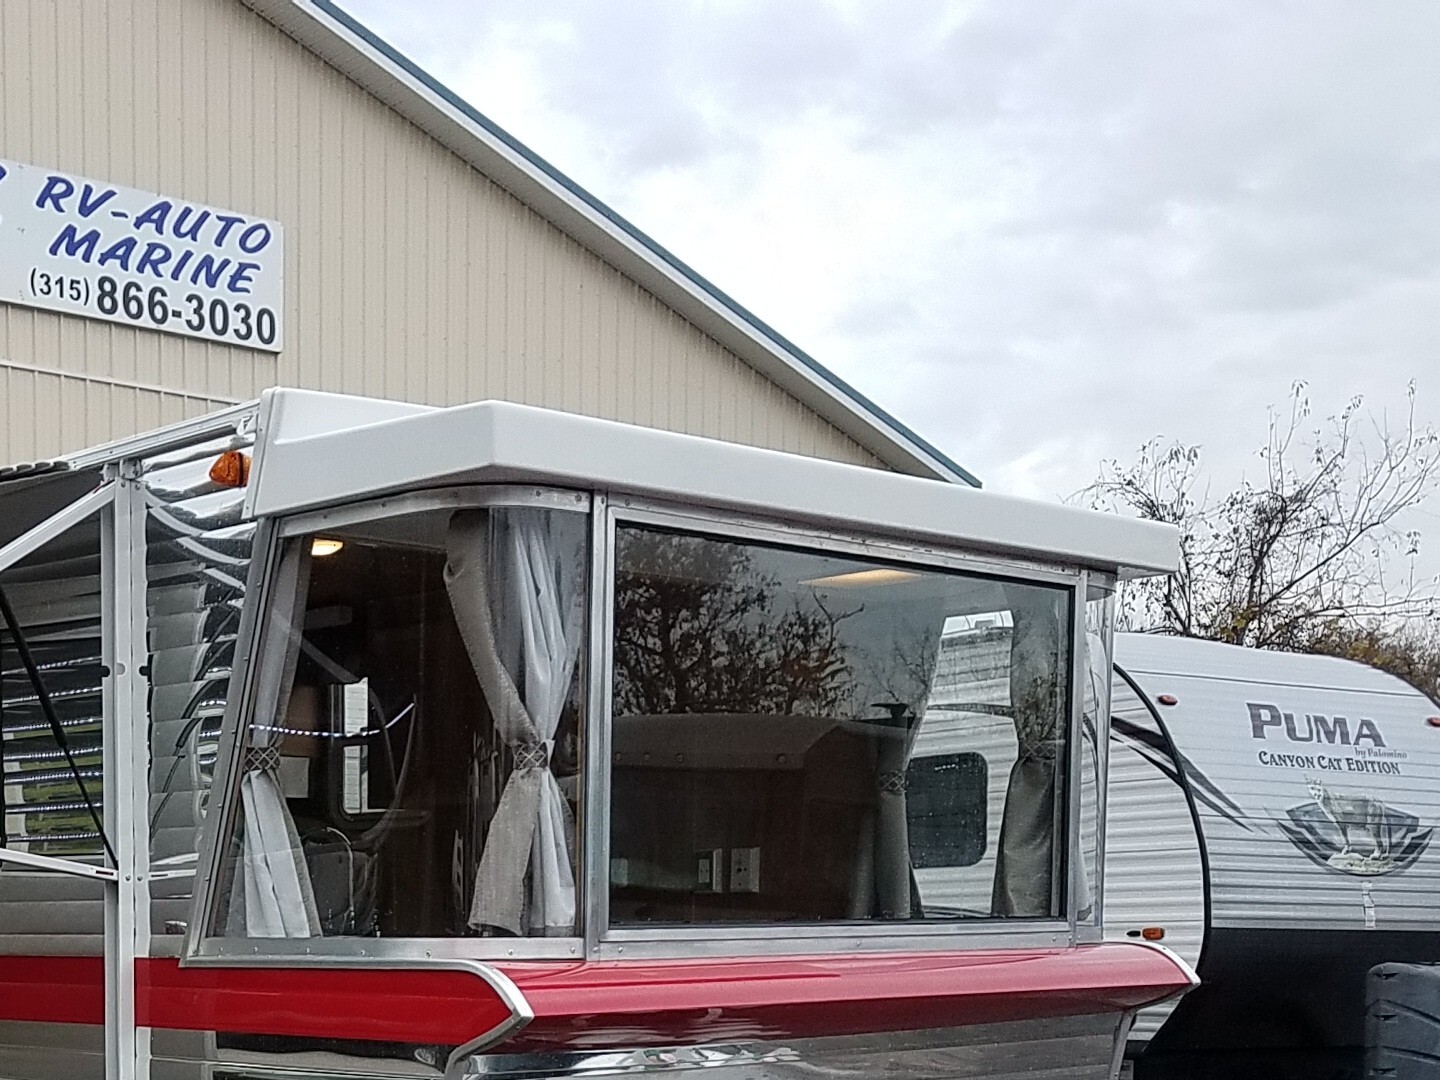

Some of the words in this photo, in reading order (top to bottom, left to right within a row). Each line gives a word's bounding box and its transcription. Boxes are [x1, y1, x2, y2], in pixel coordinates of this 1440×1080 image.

[35, 176, 272, 254] RV-AUTO
[49, 224, 261, 293] MARINE
[30, 268, 90, 306] (315)
[97, 276, 277, 345] 866-3030
[1246, 702, 1387, 748] PUMA
[1355, 748, 1366, 759] by
[1368, 749, 1408, 759] Palomino
[1258, 750, 1315, 769] CANYON
[1317, 755, 1342, 772] CAT
[1347, 757, 1401, 775] EDITION
